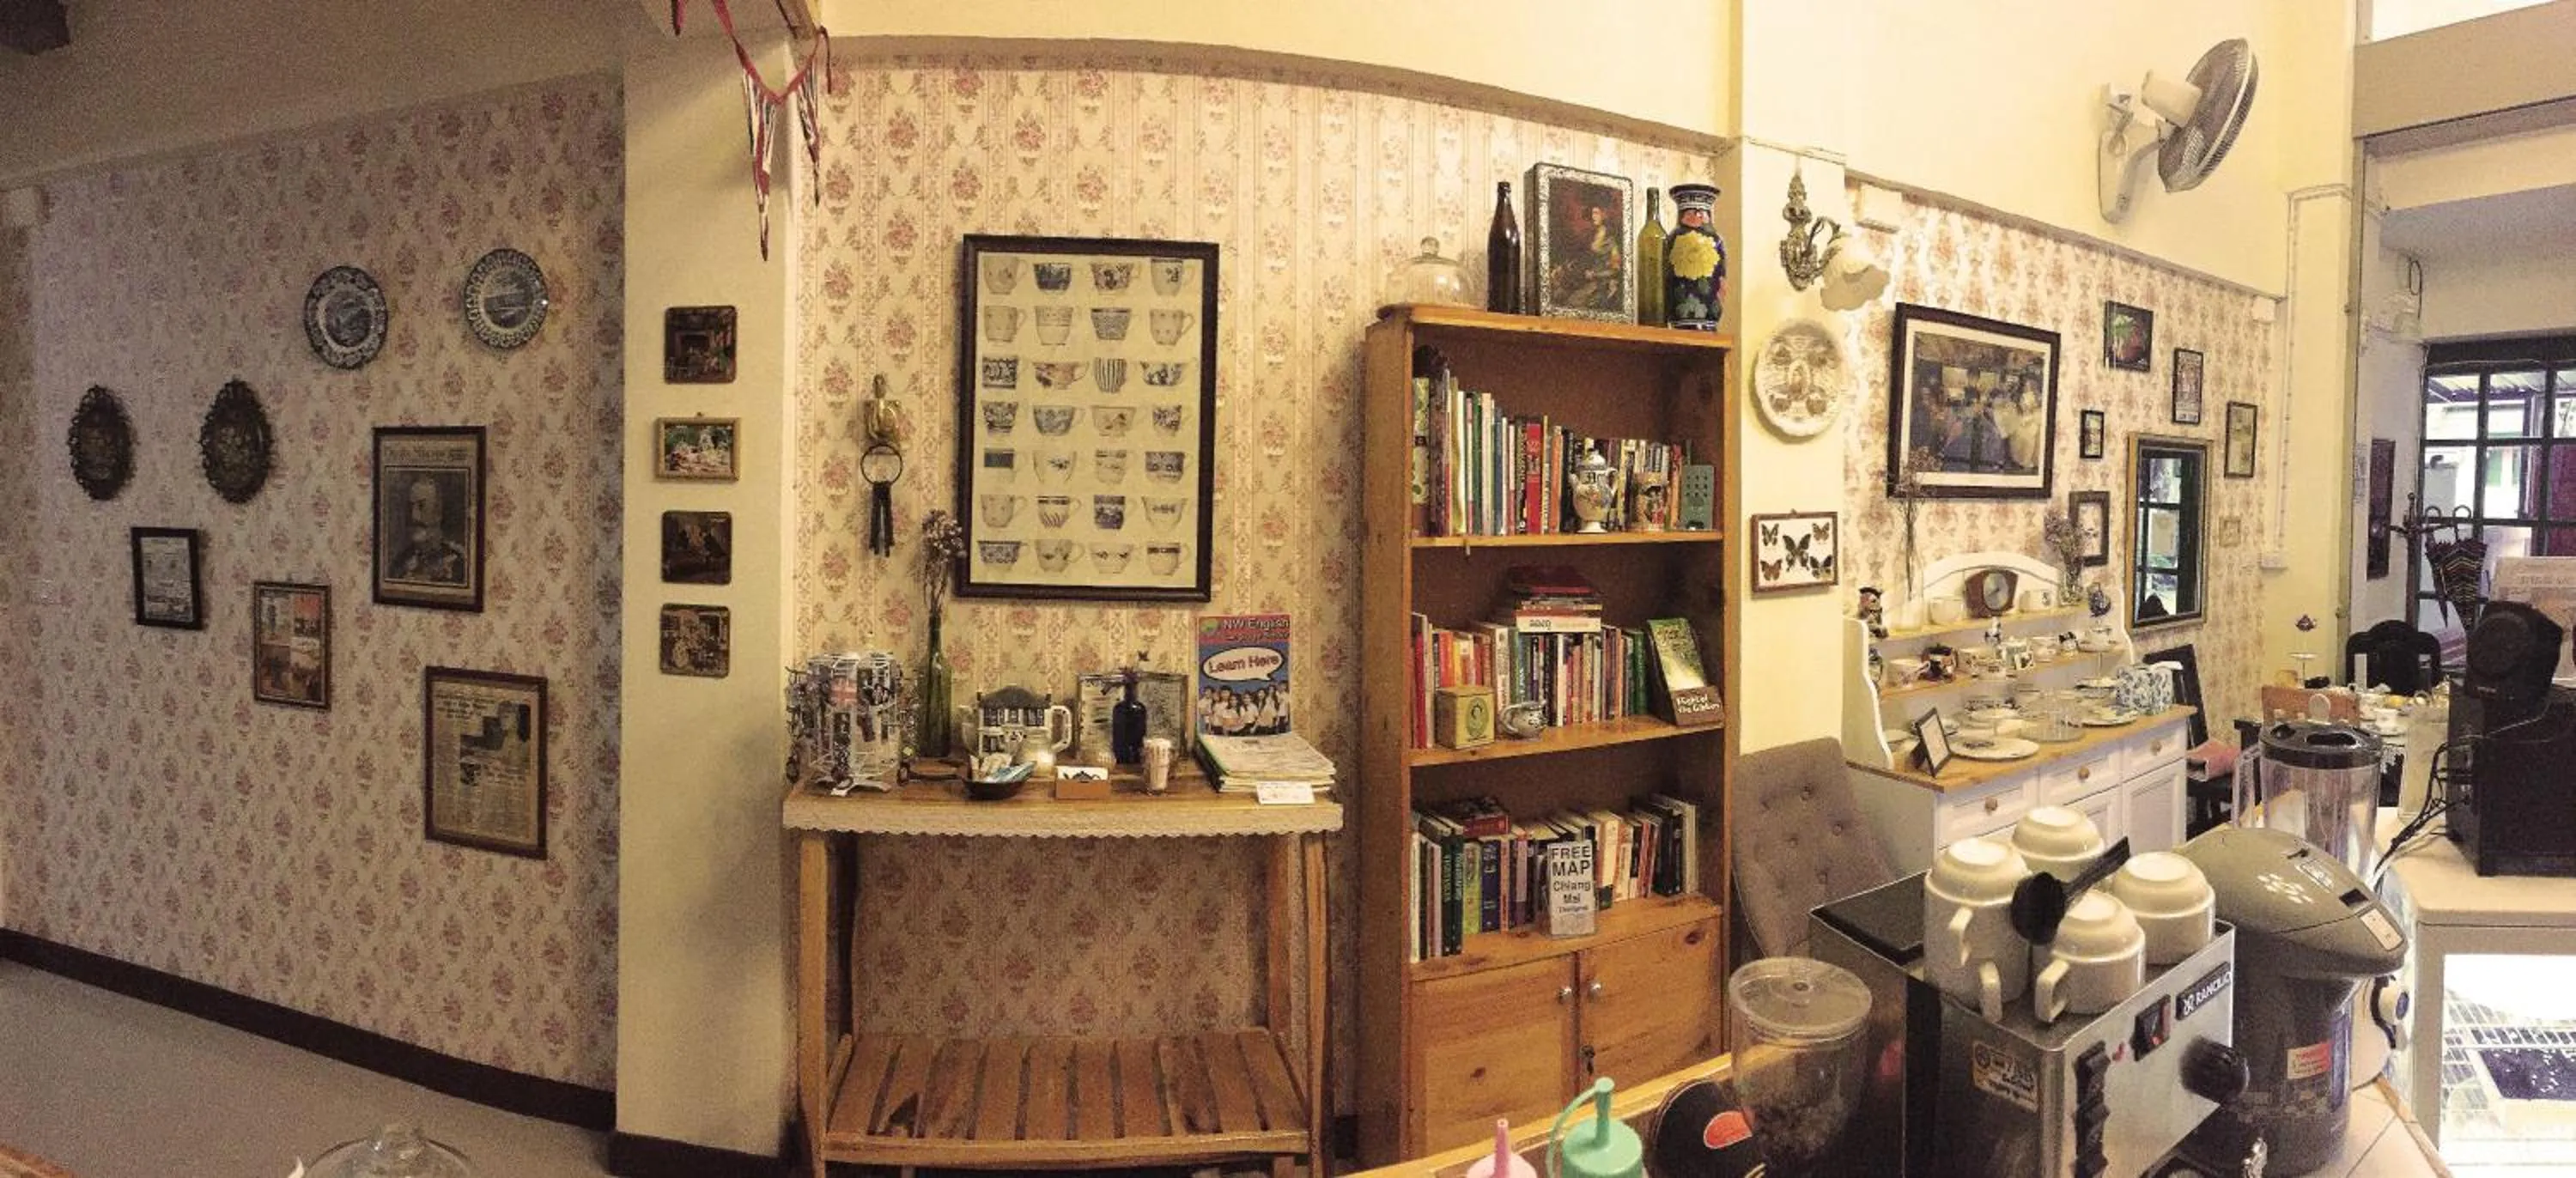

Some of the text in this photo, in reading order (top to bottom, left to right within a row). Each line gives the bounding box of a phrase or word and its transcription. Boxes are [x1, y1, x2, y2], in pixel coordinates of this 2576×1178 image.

[1223, 617, 1290, 632] NW English
[1208, 655, 1280, 674] Learn Here
[1552, 845, 1591, 859] FREE
[1552, 859, 1591, 877] MAP
[1552, 880, 1591, 892] Chiang
[1563, 892, 1582, 904] Mai
